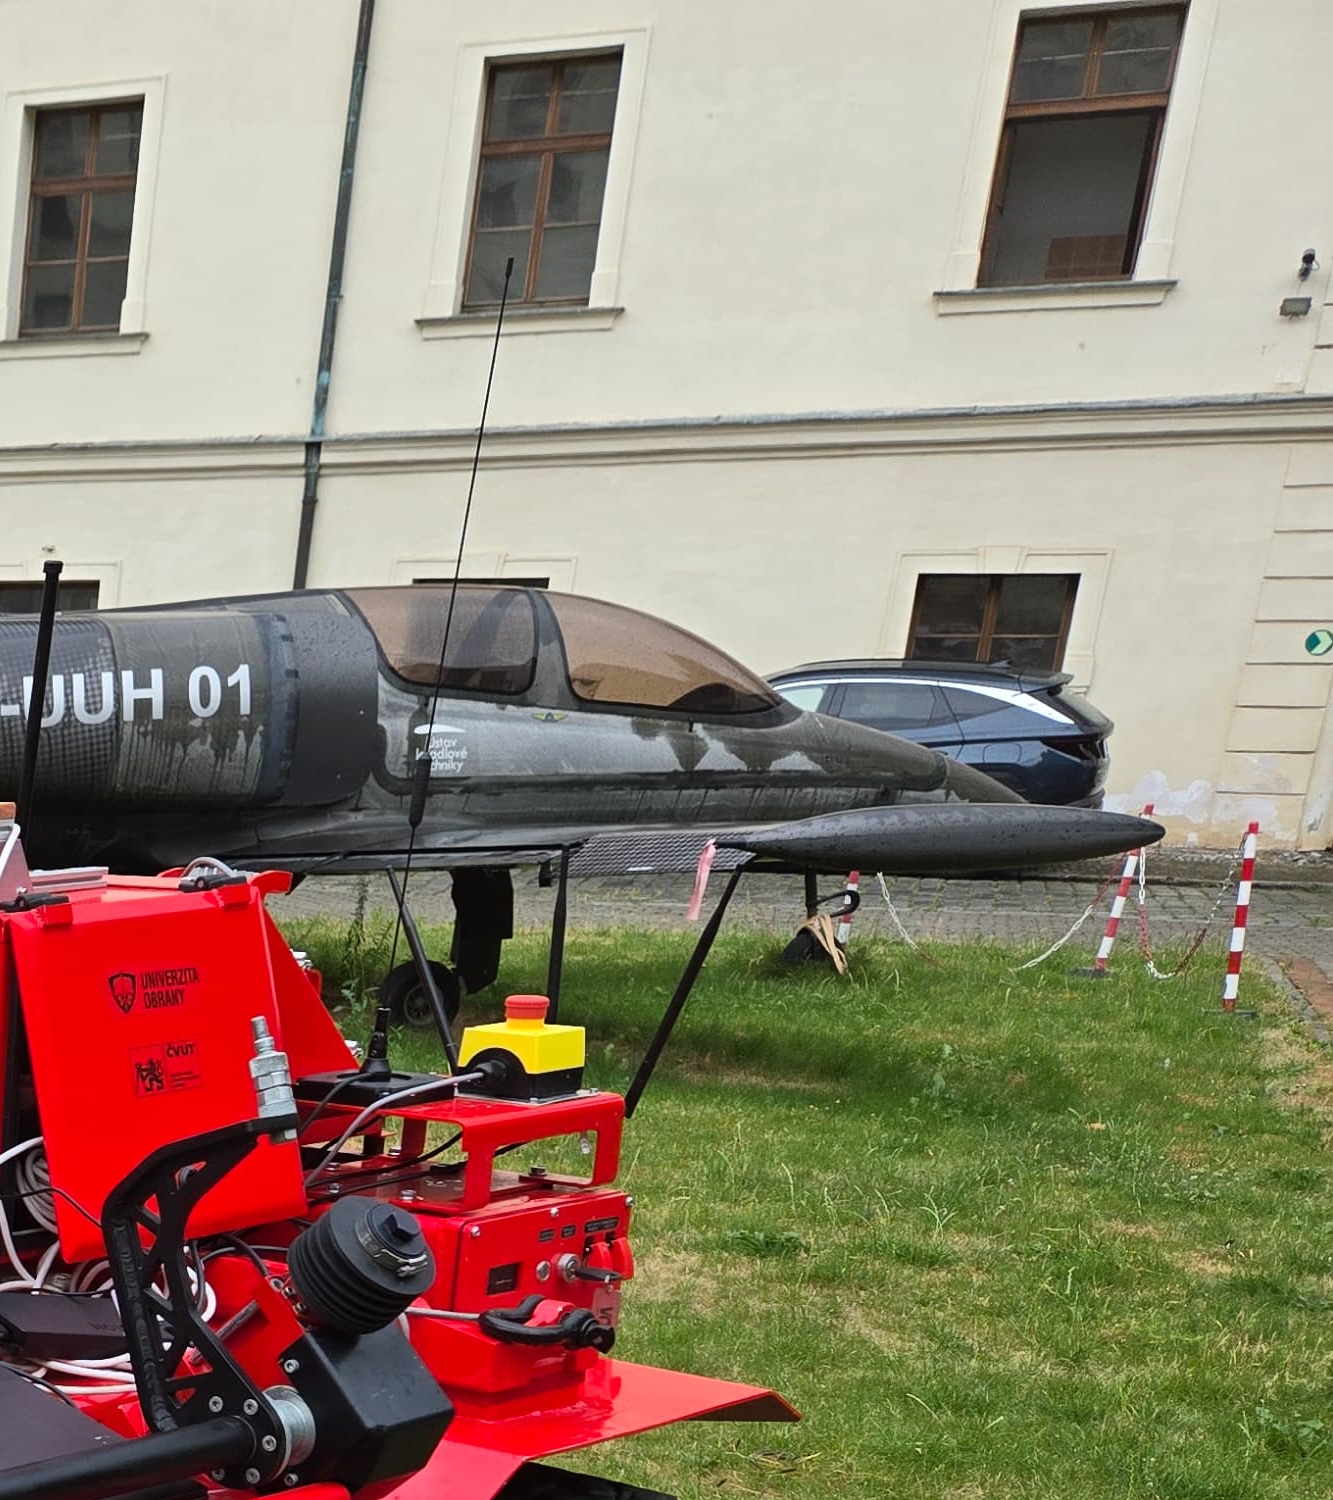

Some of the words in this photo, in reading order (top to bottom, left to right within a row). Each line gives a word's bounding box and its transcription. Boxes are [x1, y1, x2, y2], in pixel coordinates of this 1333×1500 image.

[188, 663, 252, 718] 01
[141, 968, 199, 988] UNIVERZITA
[144, 989, 184, 1009] OBRANY
